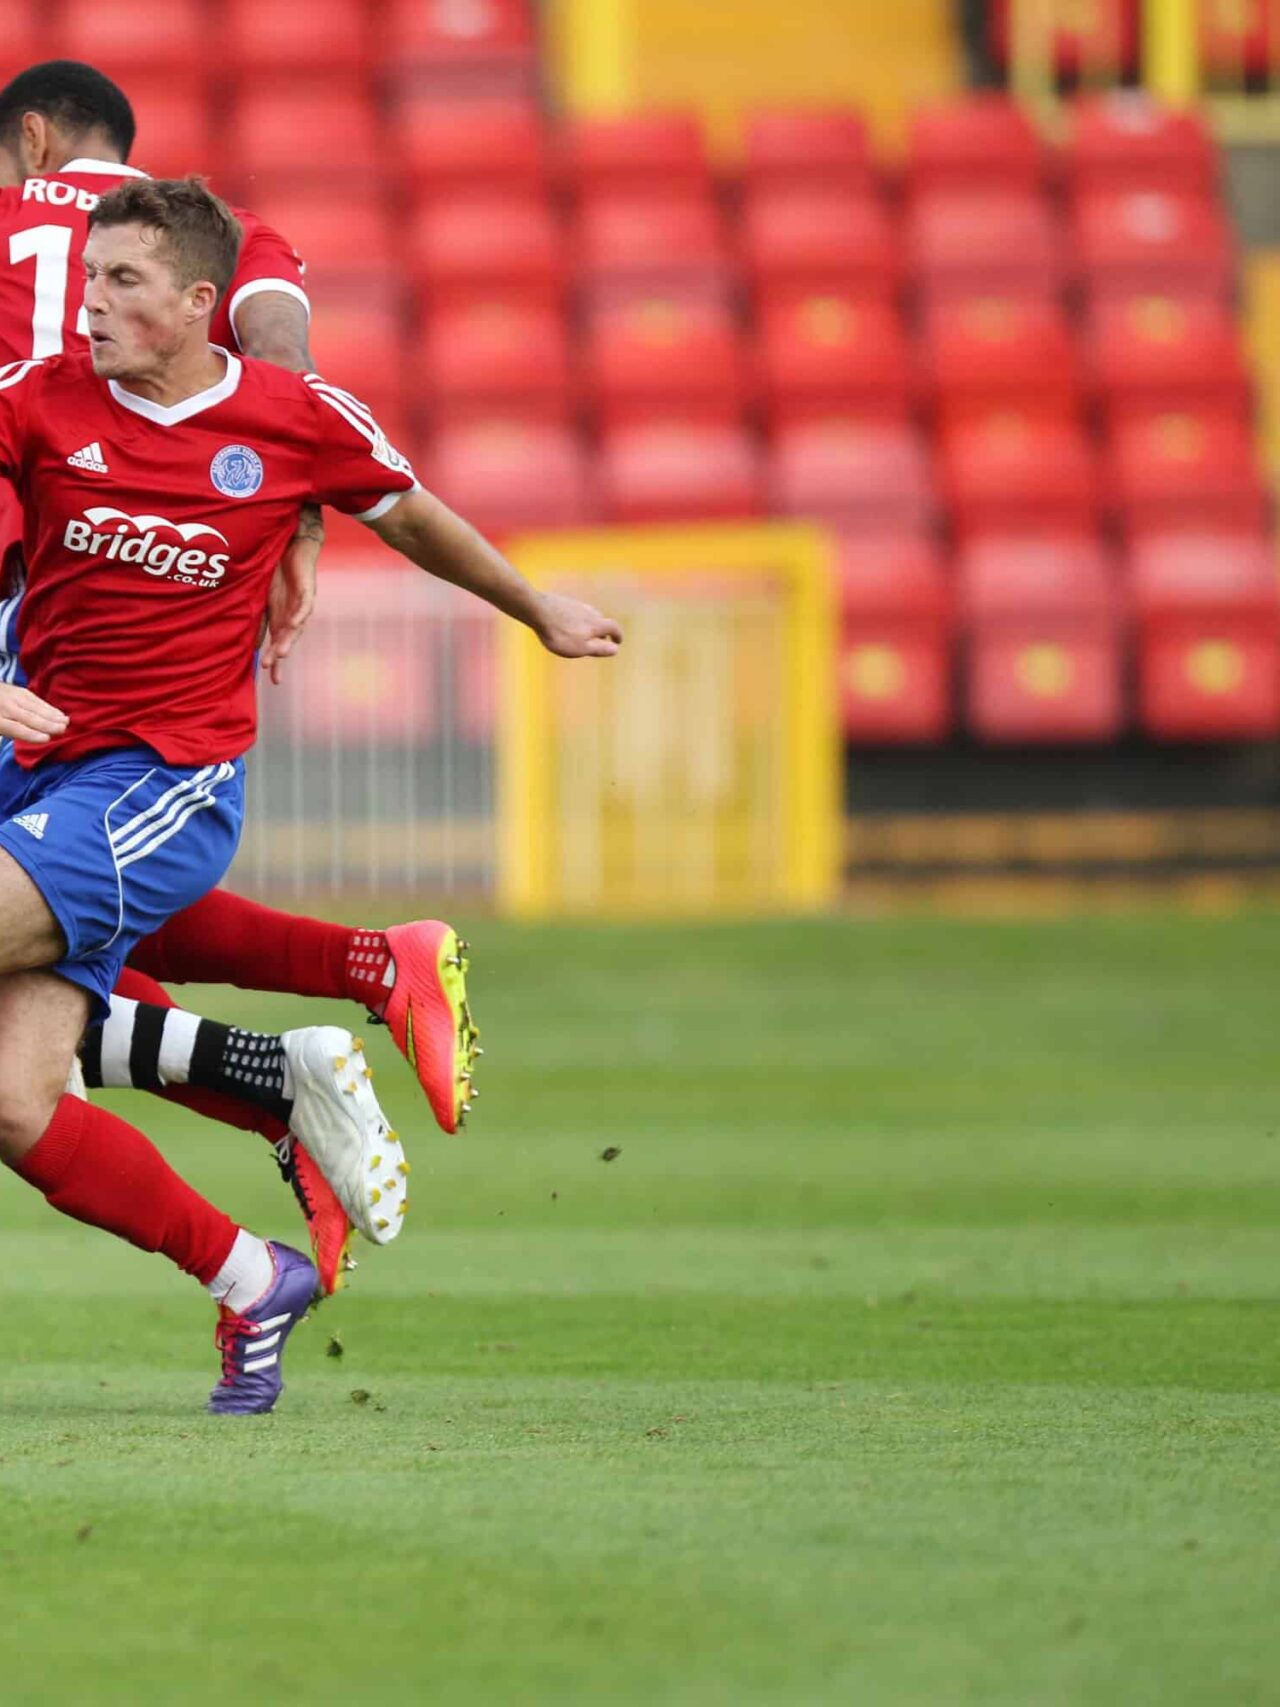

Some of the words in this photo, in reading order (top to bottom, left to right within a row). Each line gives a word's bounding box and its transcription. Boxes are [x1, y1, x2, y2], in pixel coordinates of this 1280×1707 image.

[66, 455, 109, 474] adidas
[63, 518, 229, 579] Bridges
[166, 573, 220, 588] .co.uk
[12, 817, 44, 840] adidas
